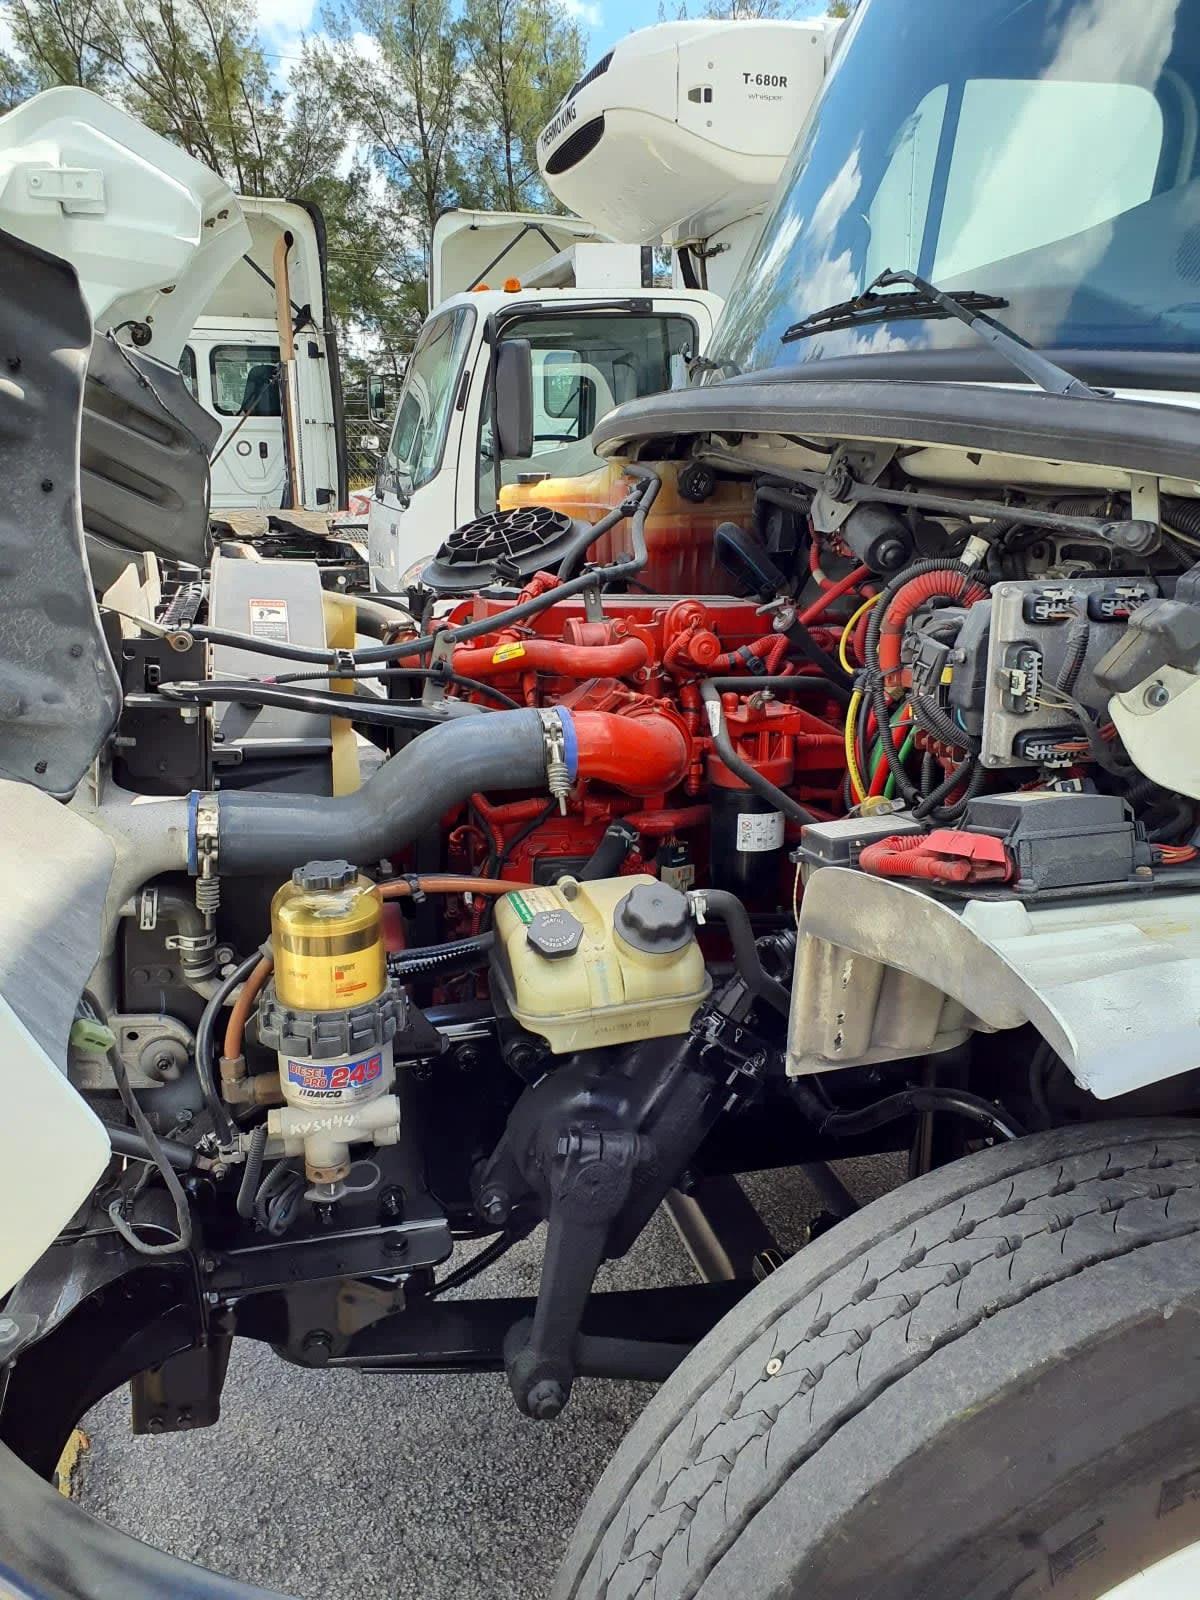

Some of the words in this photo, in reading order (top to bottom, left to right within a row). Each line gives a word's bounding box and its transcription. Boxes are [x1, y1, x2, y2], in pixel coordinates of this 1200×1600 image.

[742, 72, 787, 88] T-680R
[748, 93, 783, 102] whisper
[541, 116, 561, 152] THERMO
[562, 100, 576, 131] KING
[289, 1062, 327, 1078] DIESEL
[329, 1056, 381, 1089] 245
[303, 1076, 328, 1089] PRO
[306, 1089, 343, 1098] DAVCO
